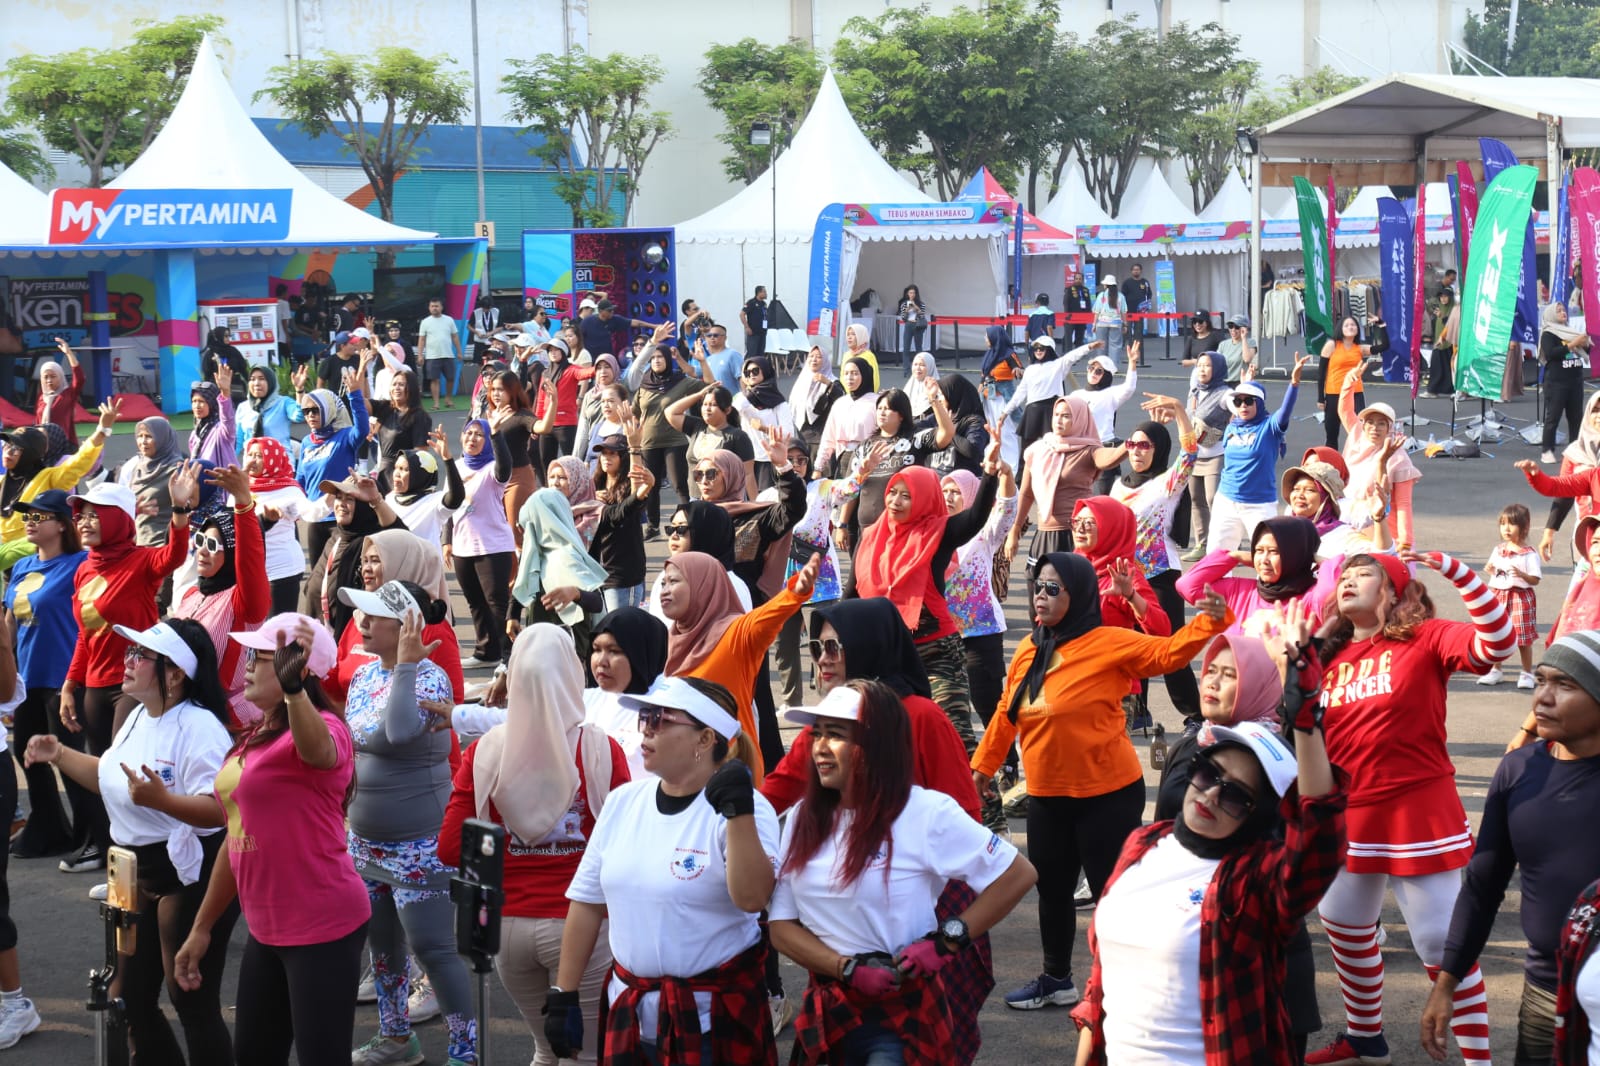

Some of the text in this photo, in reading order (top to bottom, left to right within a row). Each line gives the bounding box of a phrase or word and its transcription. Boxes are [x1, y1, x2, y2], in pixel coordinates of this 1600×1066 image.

[59, 200, 278, 240] MyPERTAMINA
[888, 209, 967, 218] TEBUS MURAH SEMBAKO
[481, 224, 489, 236] B
[12, 281, 90, 296] MyPERTAMIN
